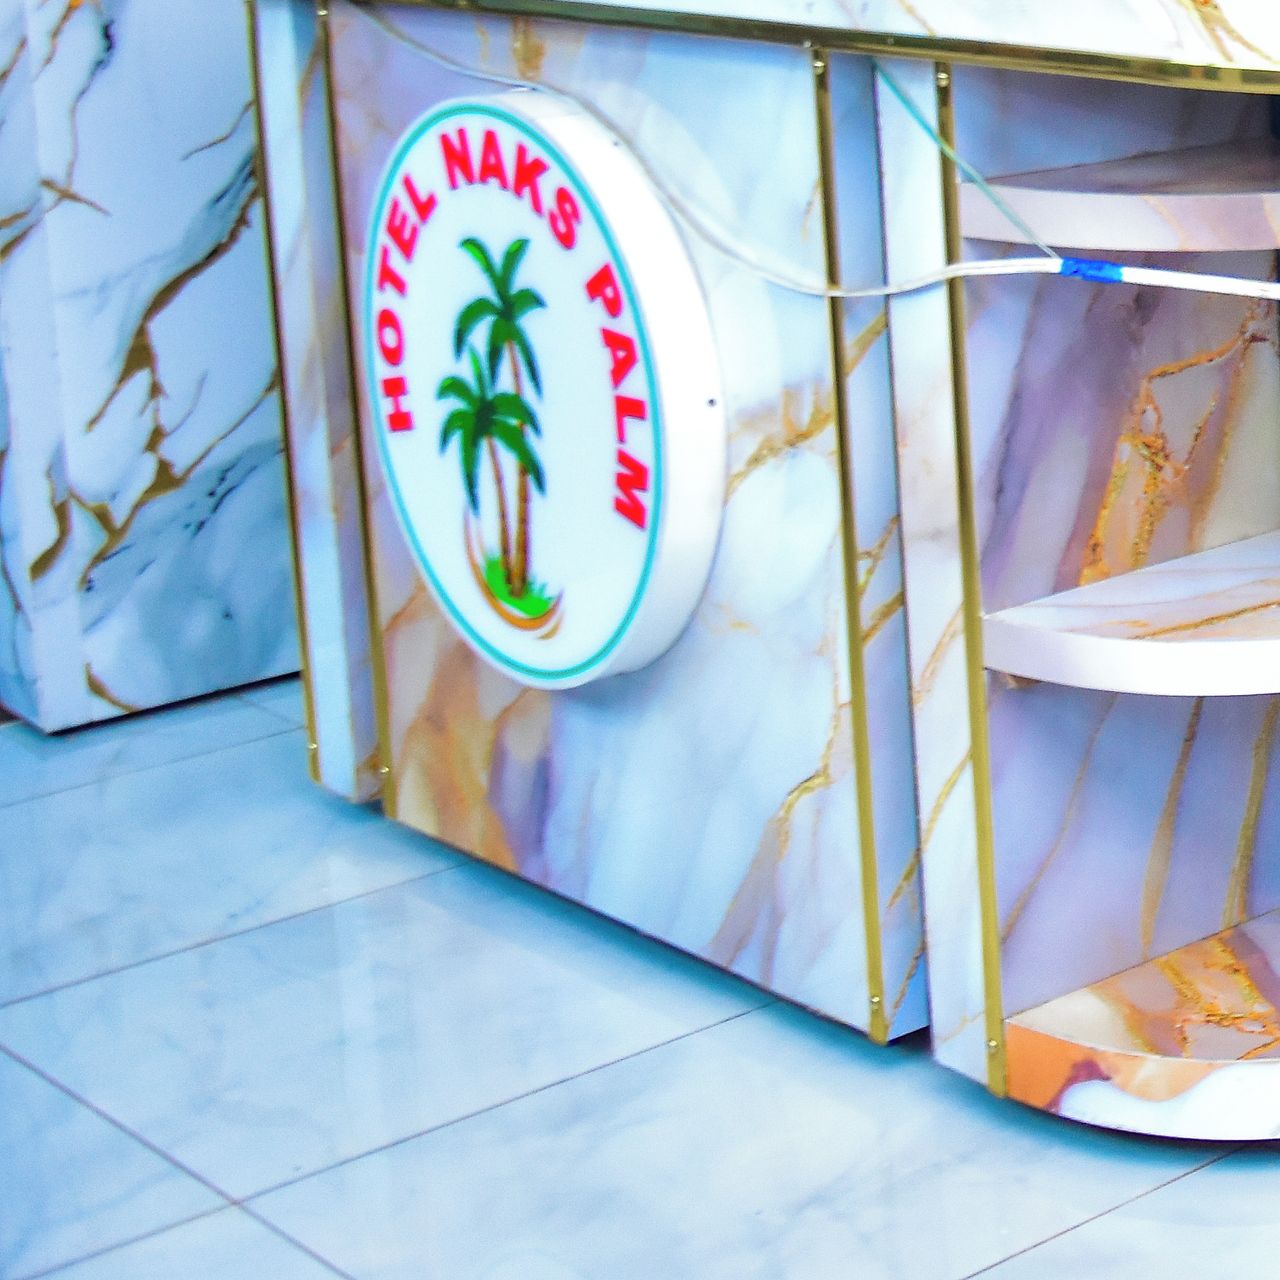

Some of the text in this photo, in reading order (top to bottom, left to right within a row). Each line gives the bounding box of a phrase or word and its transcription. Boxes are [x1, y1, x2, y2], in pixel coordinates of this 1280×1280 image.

[376, 126, 651, 531] HOTEL NAKS PALM
